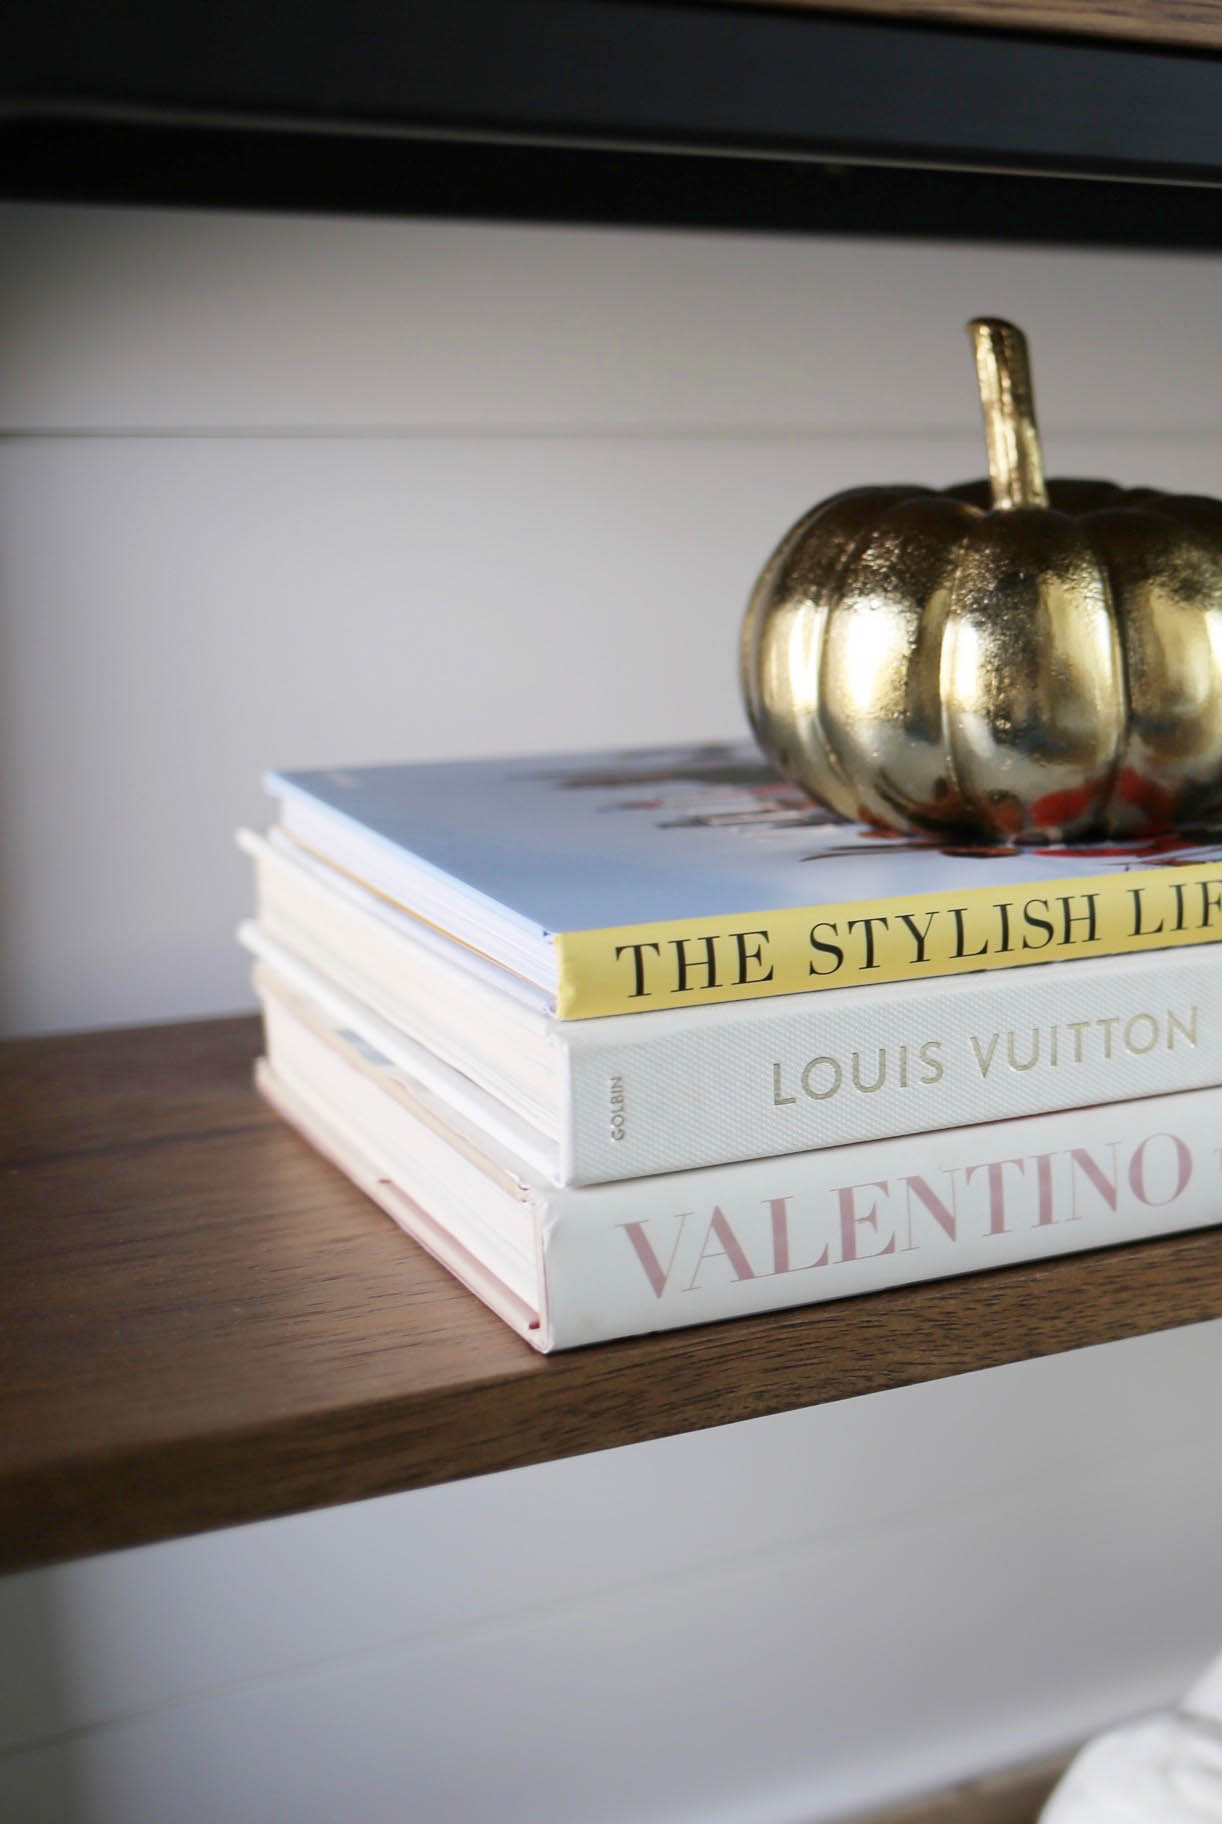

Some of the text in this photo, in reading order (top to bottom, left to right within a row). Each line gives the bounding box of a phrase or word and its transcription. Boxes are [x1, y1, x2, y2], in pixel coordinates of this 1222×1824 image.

[615, 929, 775, 999] THE
[808, 892, 1102, 977] STYLISH
[773, 1040, 944, 1106] LOUIS
[969, 1005, 1198, 1079] VUITTON
[610, 1076, 624, 1141] GOLBIN
[615, 1132, 1194, 1300] VALENTINO
